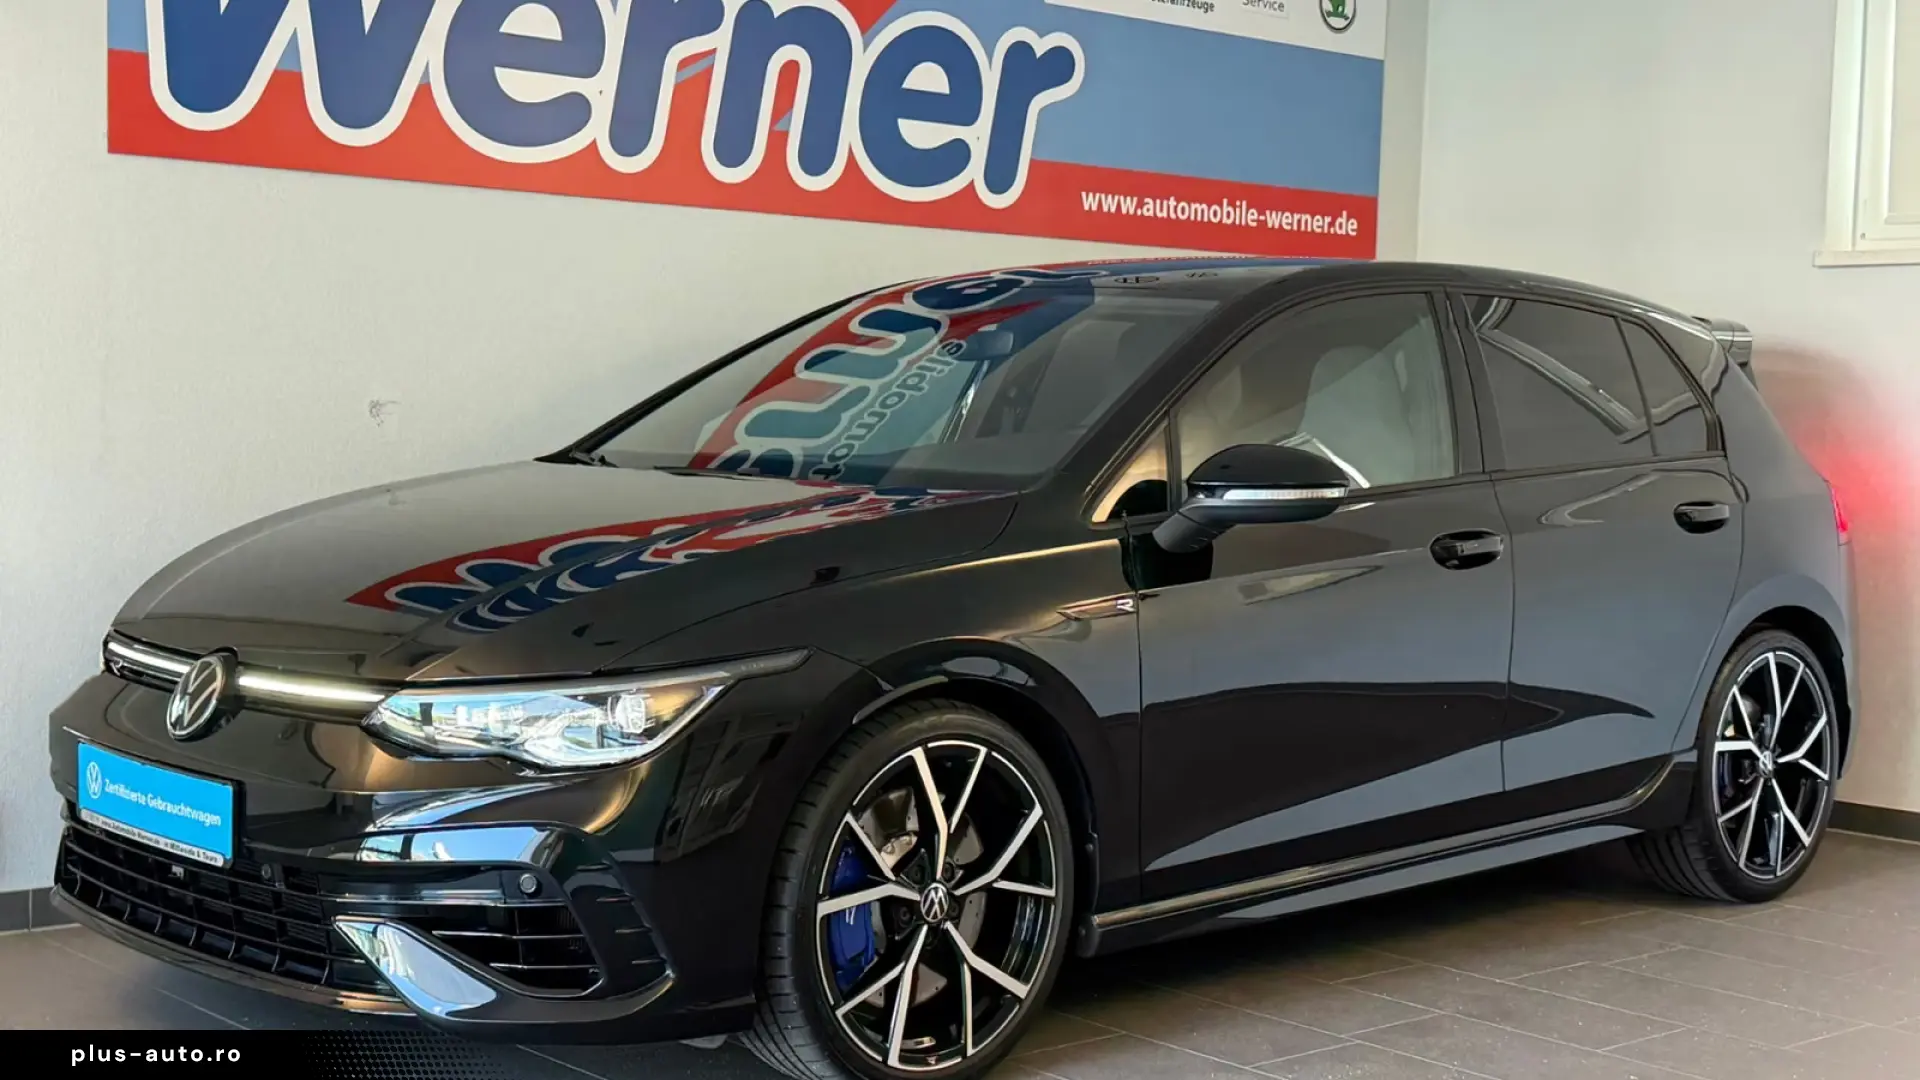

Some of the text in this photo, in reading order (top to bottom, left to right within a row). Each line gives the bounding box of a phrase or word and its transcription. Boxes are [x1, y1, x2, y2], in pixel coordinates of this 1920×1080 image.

[1080, 189, 1359, 237] www.automobile-werner.de
[104, 778, 222, 827] Zertifizierte Gebrauchtwagen
